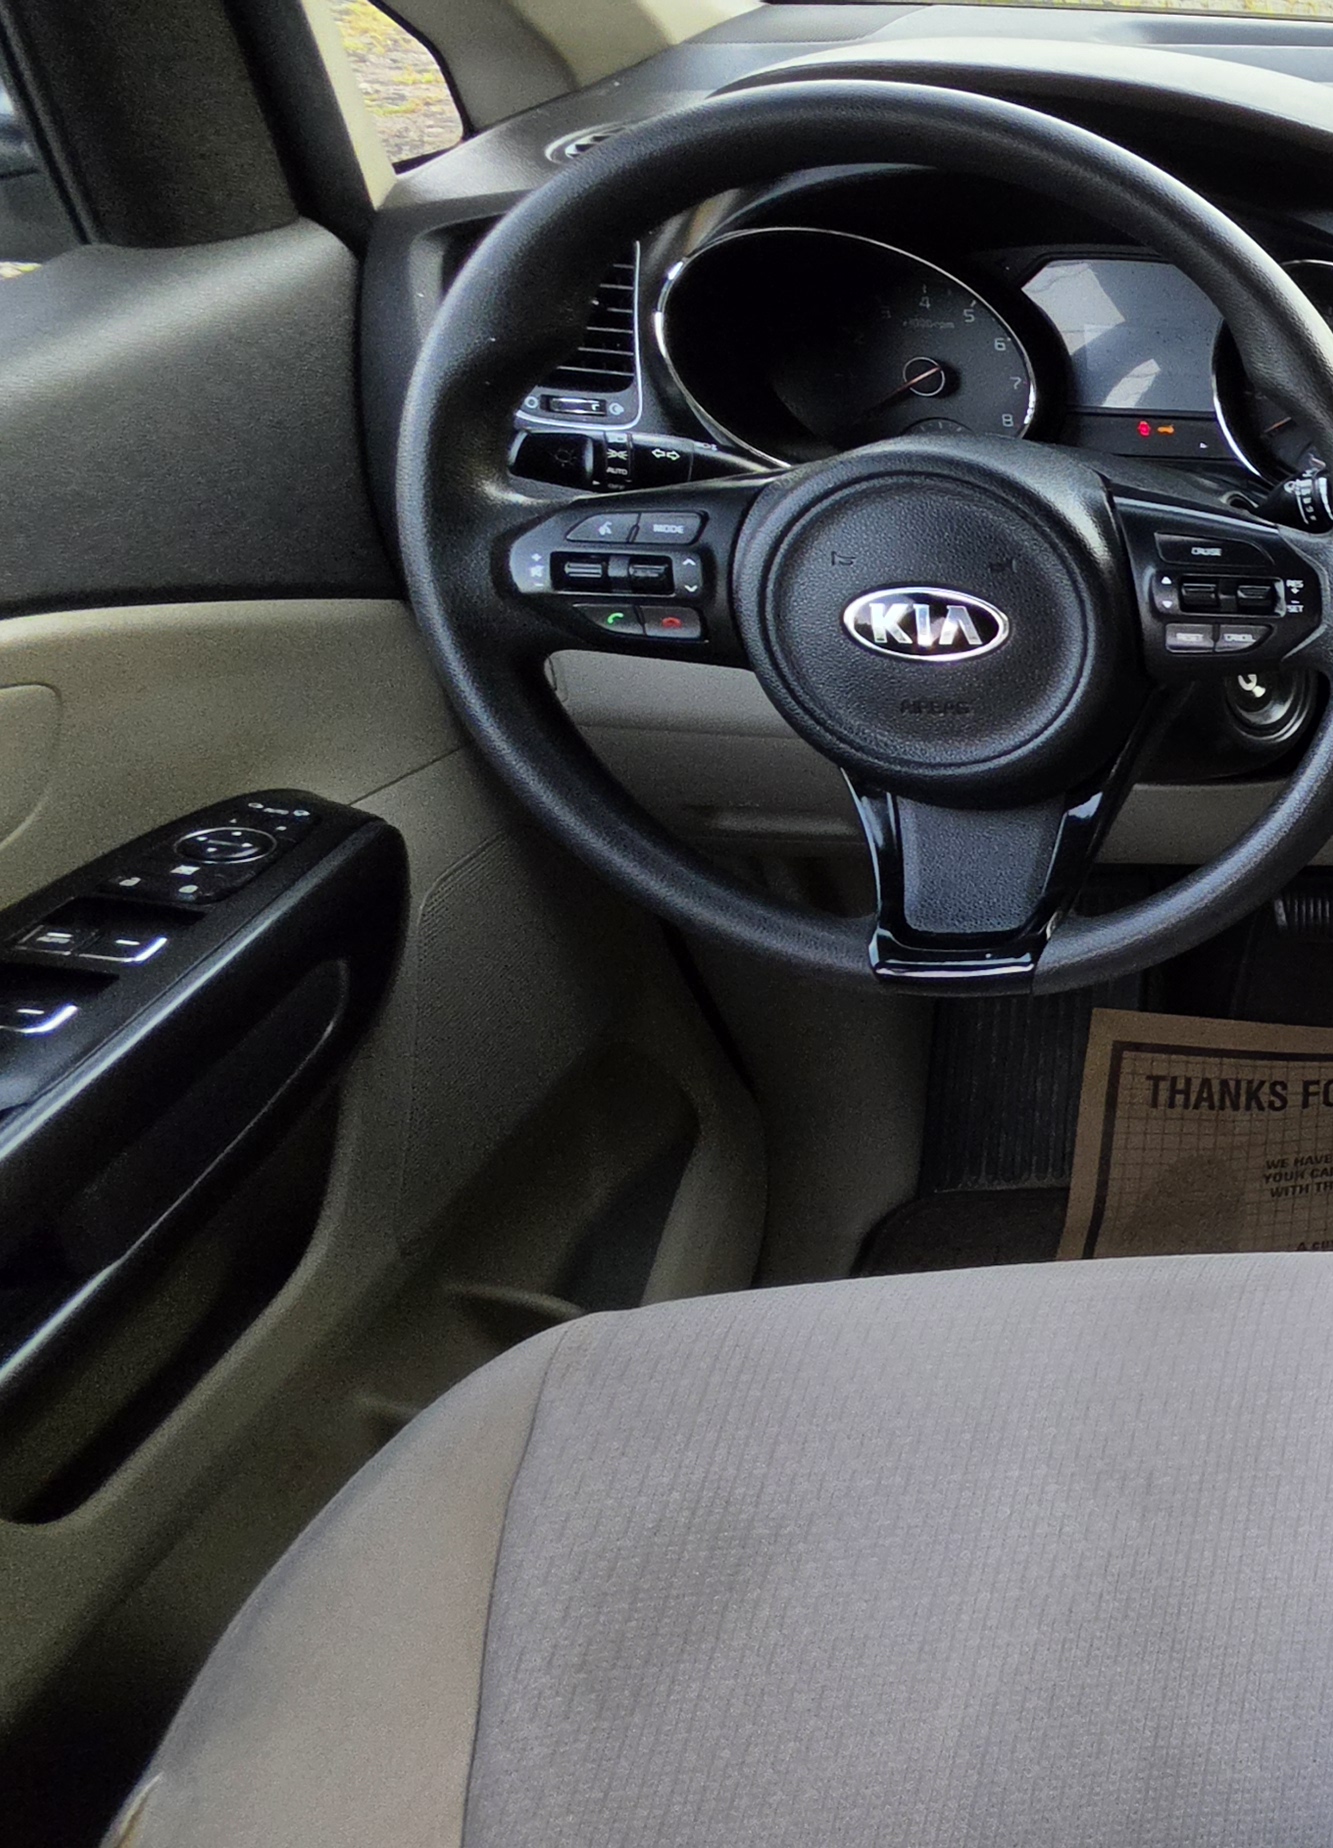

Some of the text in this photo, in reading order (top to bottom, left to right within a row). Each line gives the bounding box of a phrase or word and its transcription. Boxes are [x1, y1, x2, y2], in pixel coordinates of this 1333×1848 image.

[919, 296, 931, 309] 4
[963, 309, 976, 323] 5
[994, 338, 1006, 351] 6
[1009, 377, 1022, 390] 7
[1002, 414, 1014, 427] 8
[606, 467, 628, 476] AUTO
[653, 523, 684, 534] MODE
[1286, 605, 1305, 613] SET
[868, 602, 983, 646] KIA
[1146, 1075, 1289, 1112] THANKS
[1265, 1158, 1289, 1170] WE
[1293, 1153, 1333, 1167] HAVE
[1263, 1170, 1306, 1185] YOUR
[1270, 1184, 1309, 1199] WITH
[1297, 1241, 1308, 1251] A
